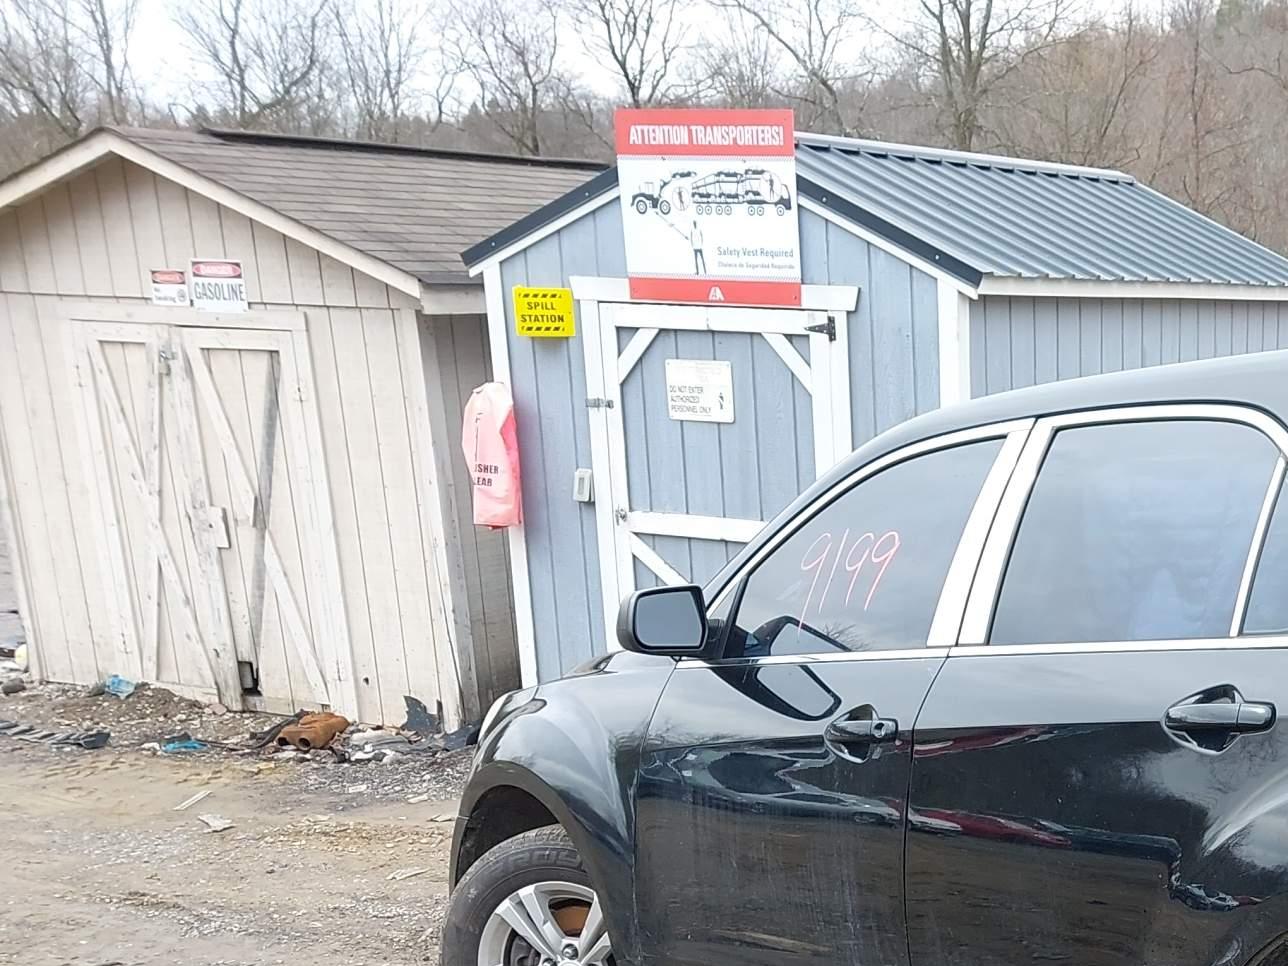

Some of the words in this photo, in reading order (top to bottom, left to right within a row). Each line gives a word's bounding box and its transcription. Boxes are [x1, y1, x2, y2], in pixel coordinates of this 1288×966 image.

[629, 125, 689, 145] ATTENTION
[690, 125, 784, 146] TRANSPORTERS!
[717, 246, 740, 258] Safety
[741, 247, 758, 257] Vest
[760, 247, 794, 260] Required
[193, 282, 246, 302] GASOLINE
[527, 301, 557, 311] SPILL
[520, 314, 565, 323] STATION
[797, 527, 901, 637] 9199
